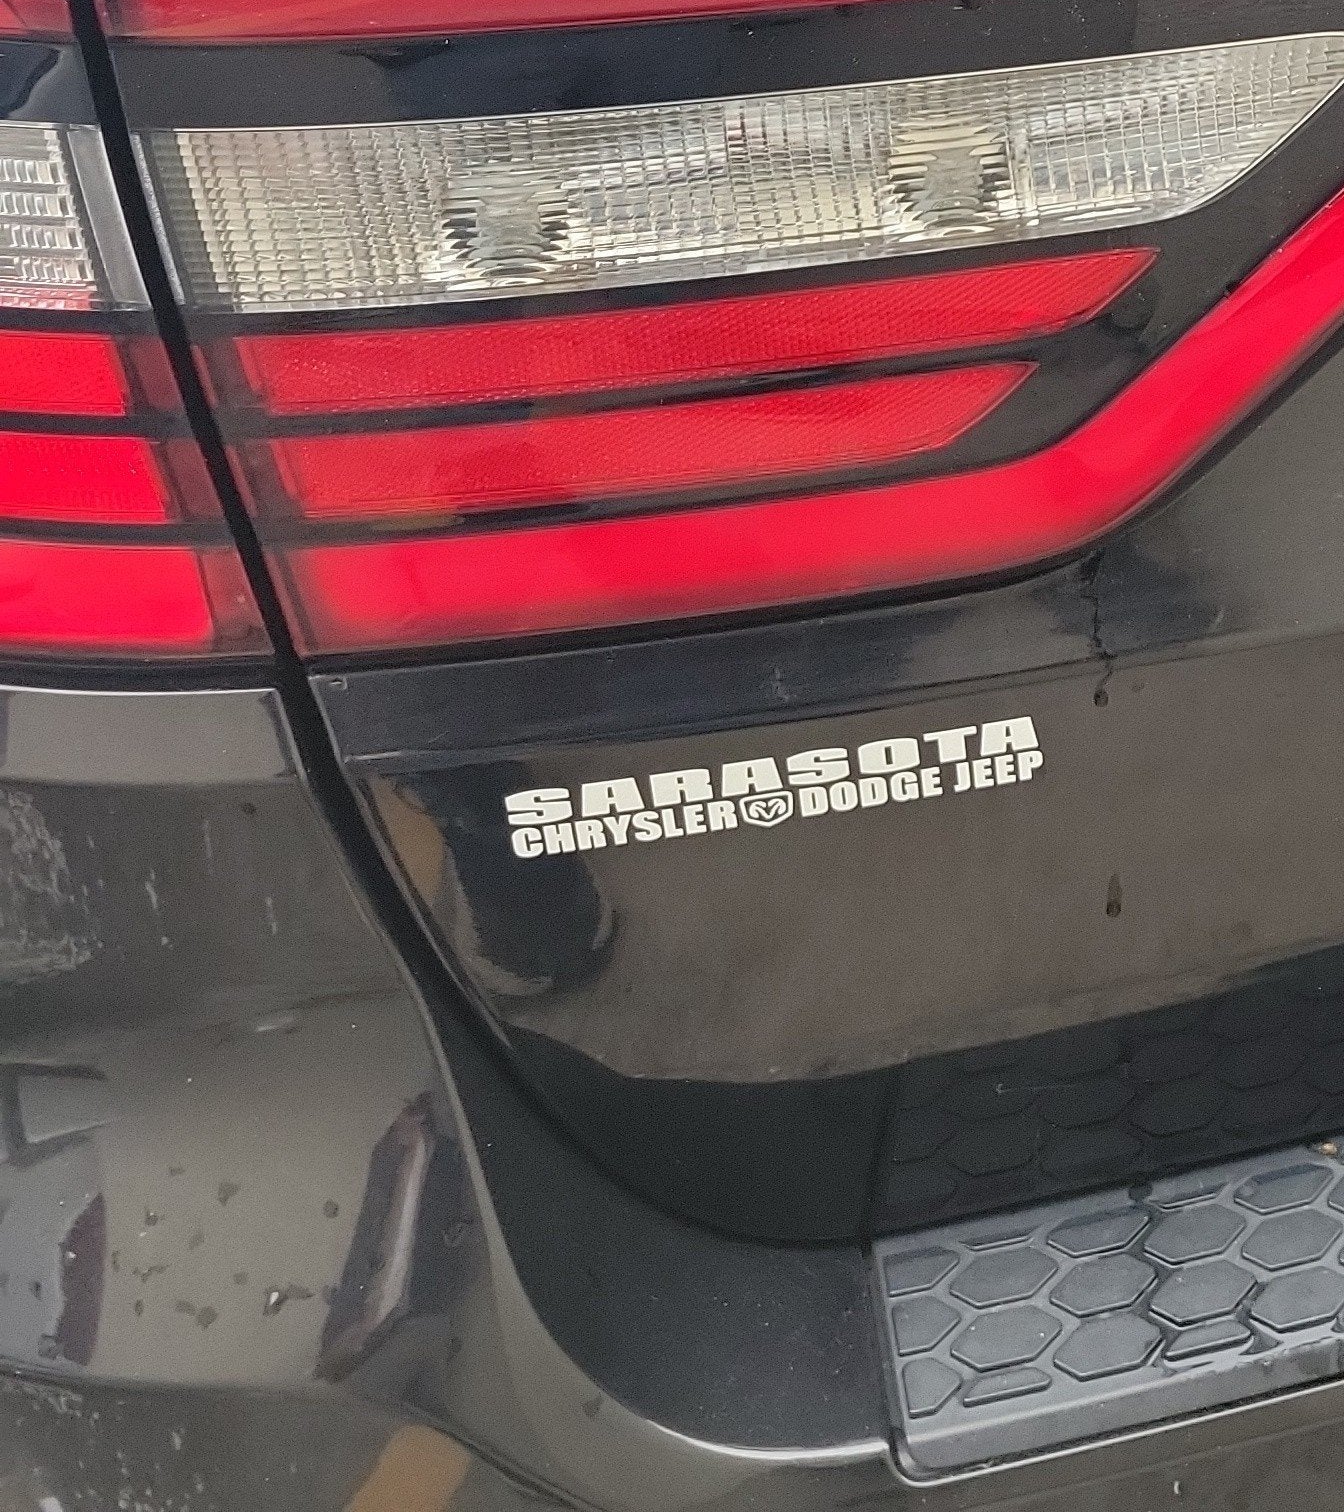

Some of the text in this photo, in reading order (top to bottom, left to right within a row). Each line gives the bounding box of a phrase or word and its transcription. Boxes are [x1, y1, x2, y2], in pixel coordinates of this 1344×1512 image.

[504, 716, 1040, 826] SARASOTA
[511, 750, 1045, 859] CHRYSLER DODGE JEEP
